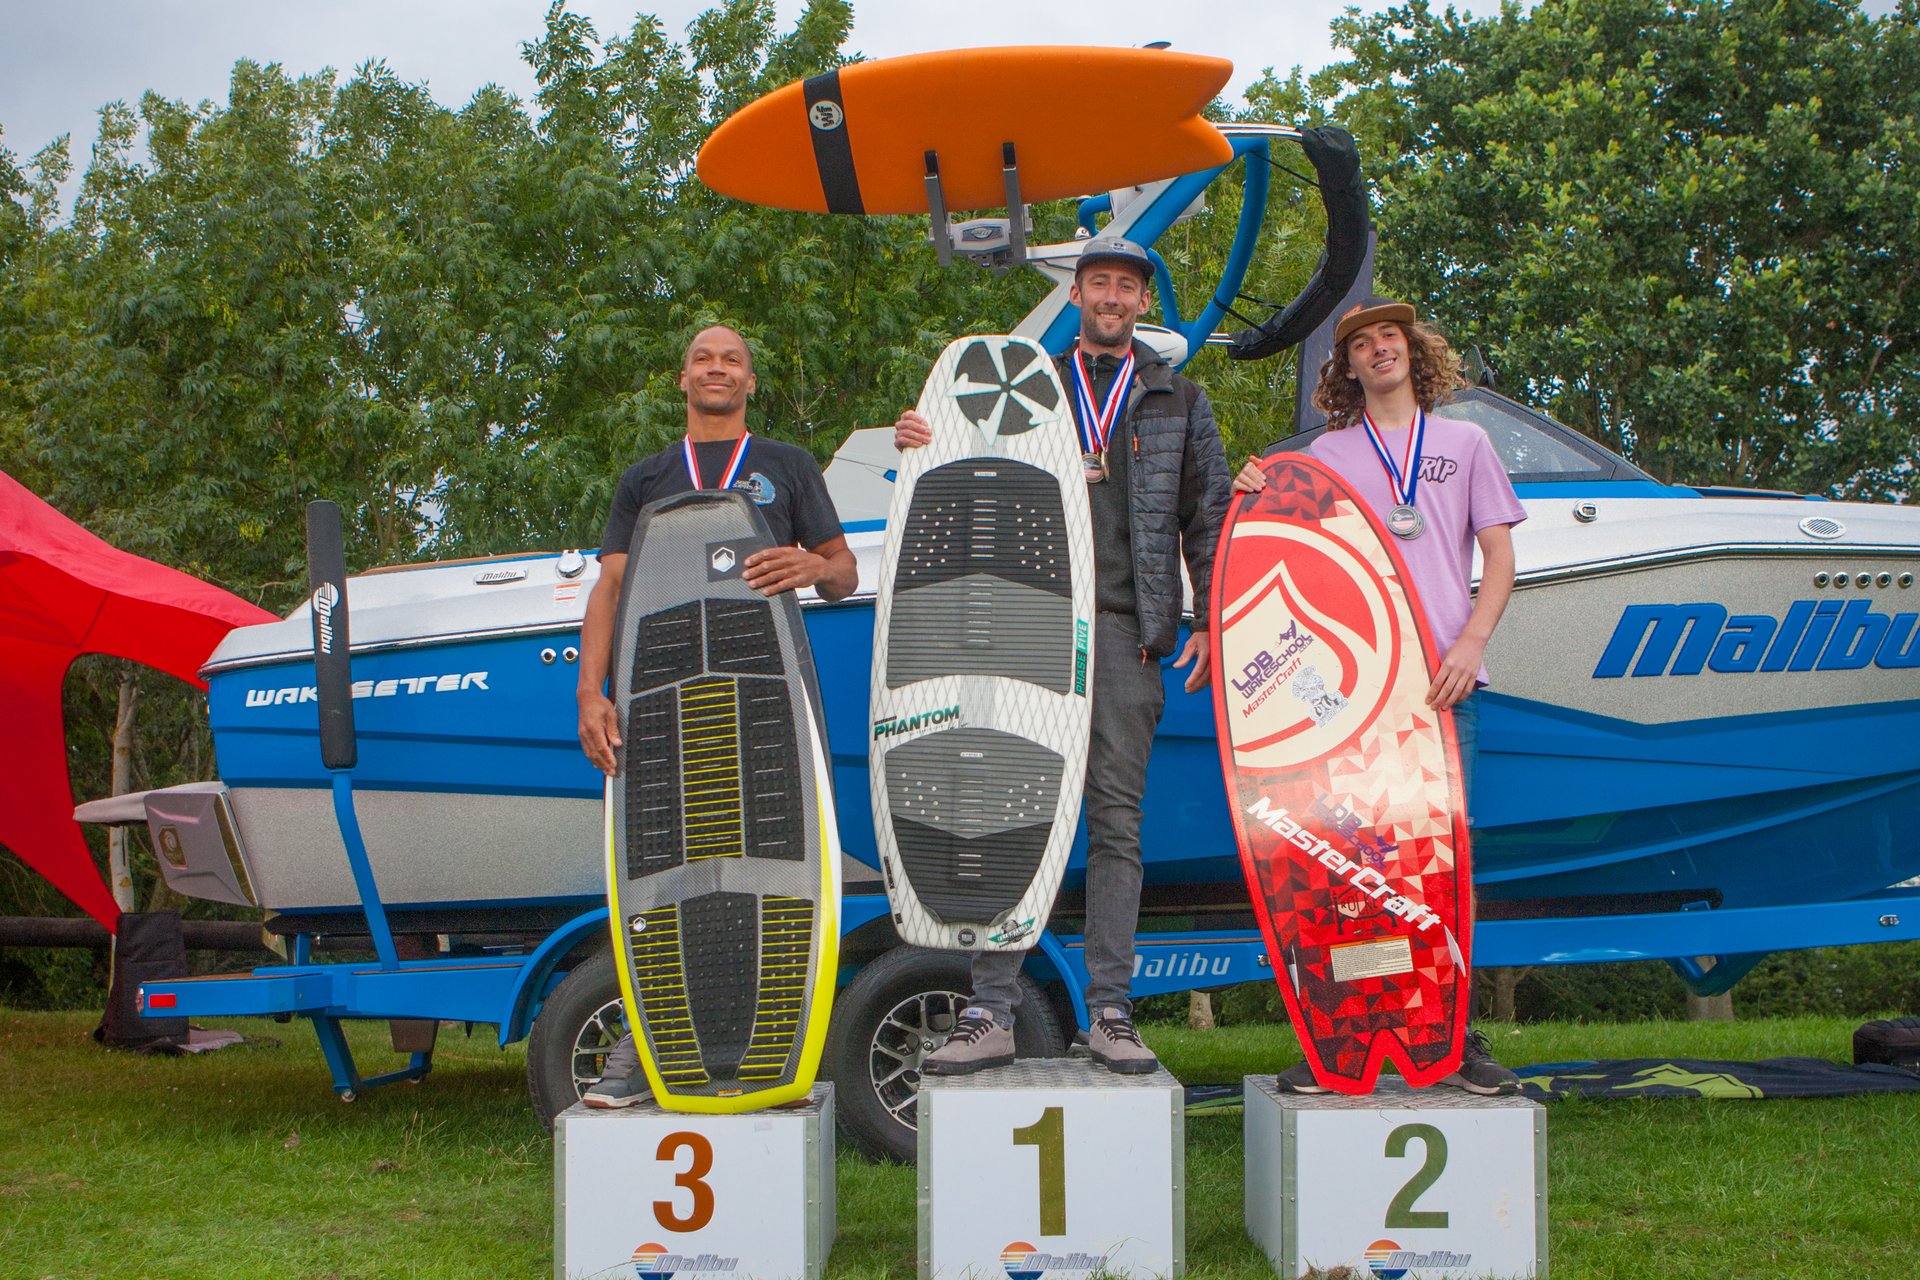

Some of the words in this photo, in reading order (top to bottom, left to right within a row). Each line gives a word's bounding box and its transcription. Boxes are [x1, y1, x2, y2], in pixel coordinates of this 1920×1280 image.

[481, 571, 518, 581] Malibu
[319, 594, 333, 655] Malibu
[1077, 623, 1088, 650] FIVE
[1591, 599, 1920, 679] Malibu
[1075, 653, 1087, 695] PHASE
[1231, 650, 1273, 691] LDB
[1241, 633, 1312, 699] WAKESCHOOL
[245, 671, 489, 708] WAKSETTER
[1242, 657, 1302, 719] MasterCraft
[874, 704, 960, 741] PHANTOM
[1246, 796, 1442, 932] MasterCraft
[653, 1131, 715, 1233] 3
[1013, 1106, 1067, 1236] 1
[1384, 1123, 1449, 1229] 2
[652, 1254, 739, 1271] Malibu
[1021, 1252, 1107, 1270] Malibu
[1384, 1250, 1472, 1268] Malibu
